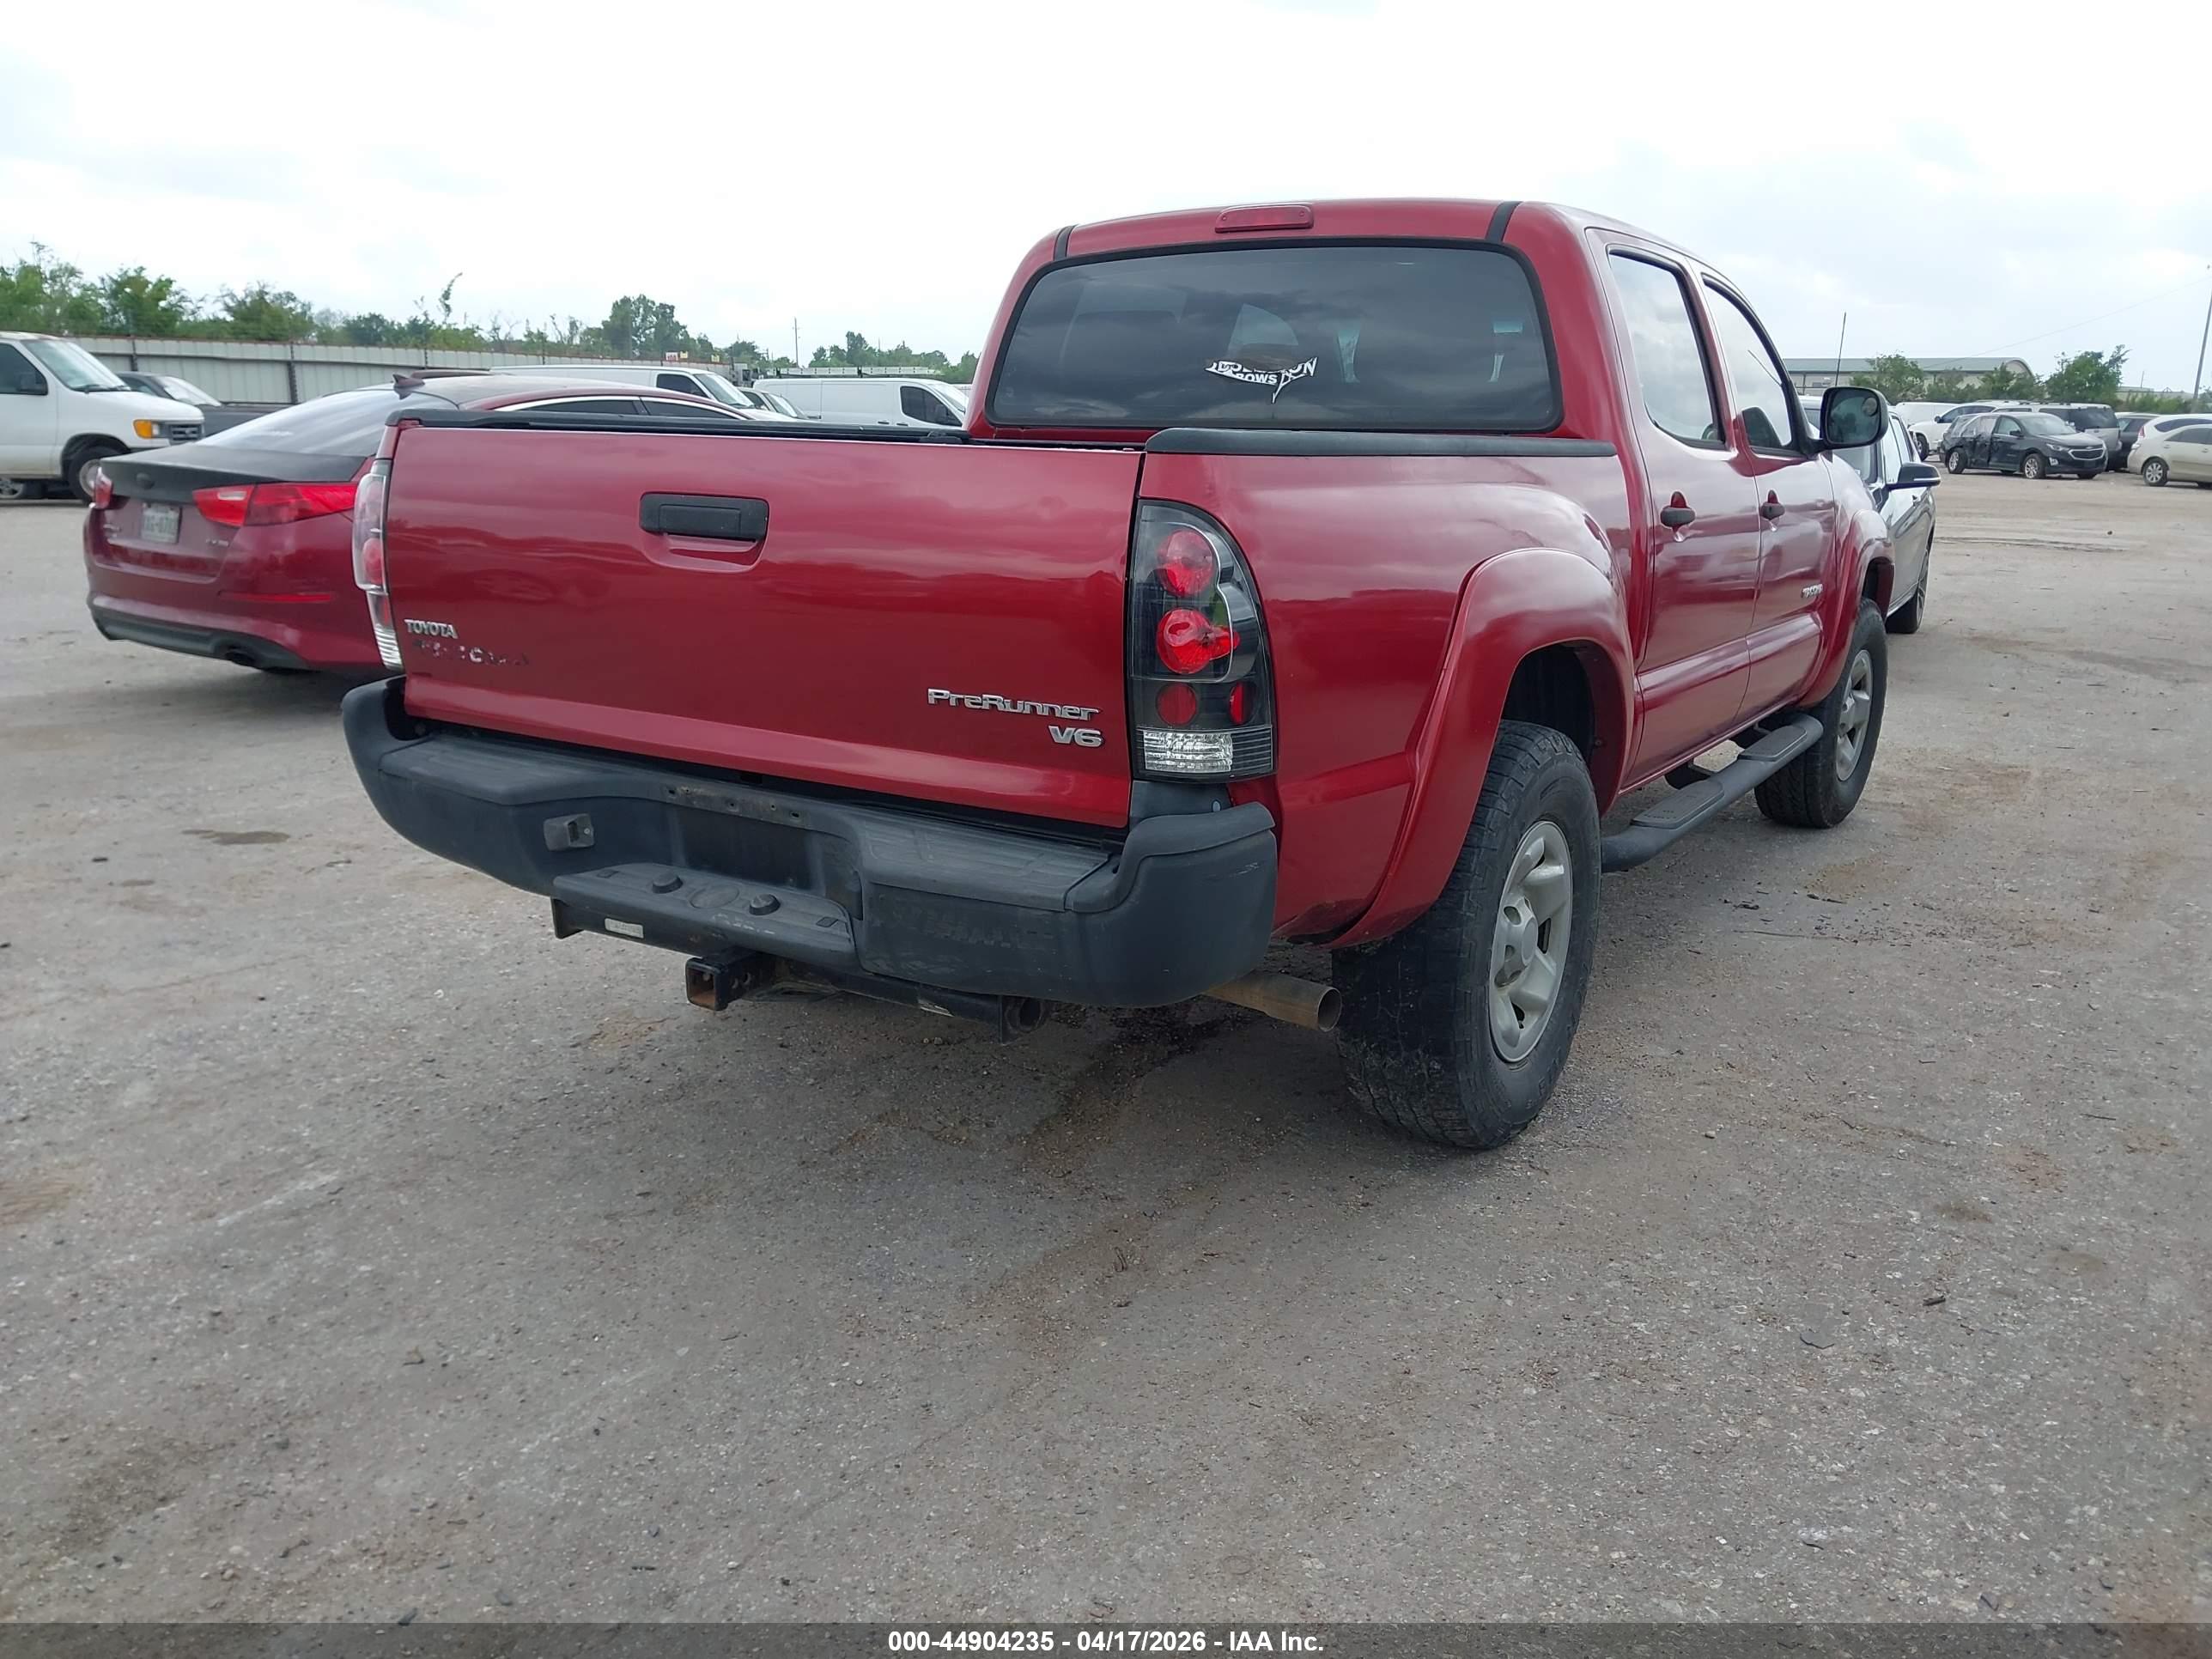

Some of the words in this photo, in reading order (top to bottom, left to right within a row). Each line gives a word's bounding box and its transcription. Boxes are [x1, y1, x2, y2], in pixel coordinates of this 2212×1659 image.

[404, 618, 459, 639] TOYOTA
[927, 688, 1100, 721] PreRunner
[1048, 725, 1104, 748] V6
